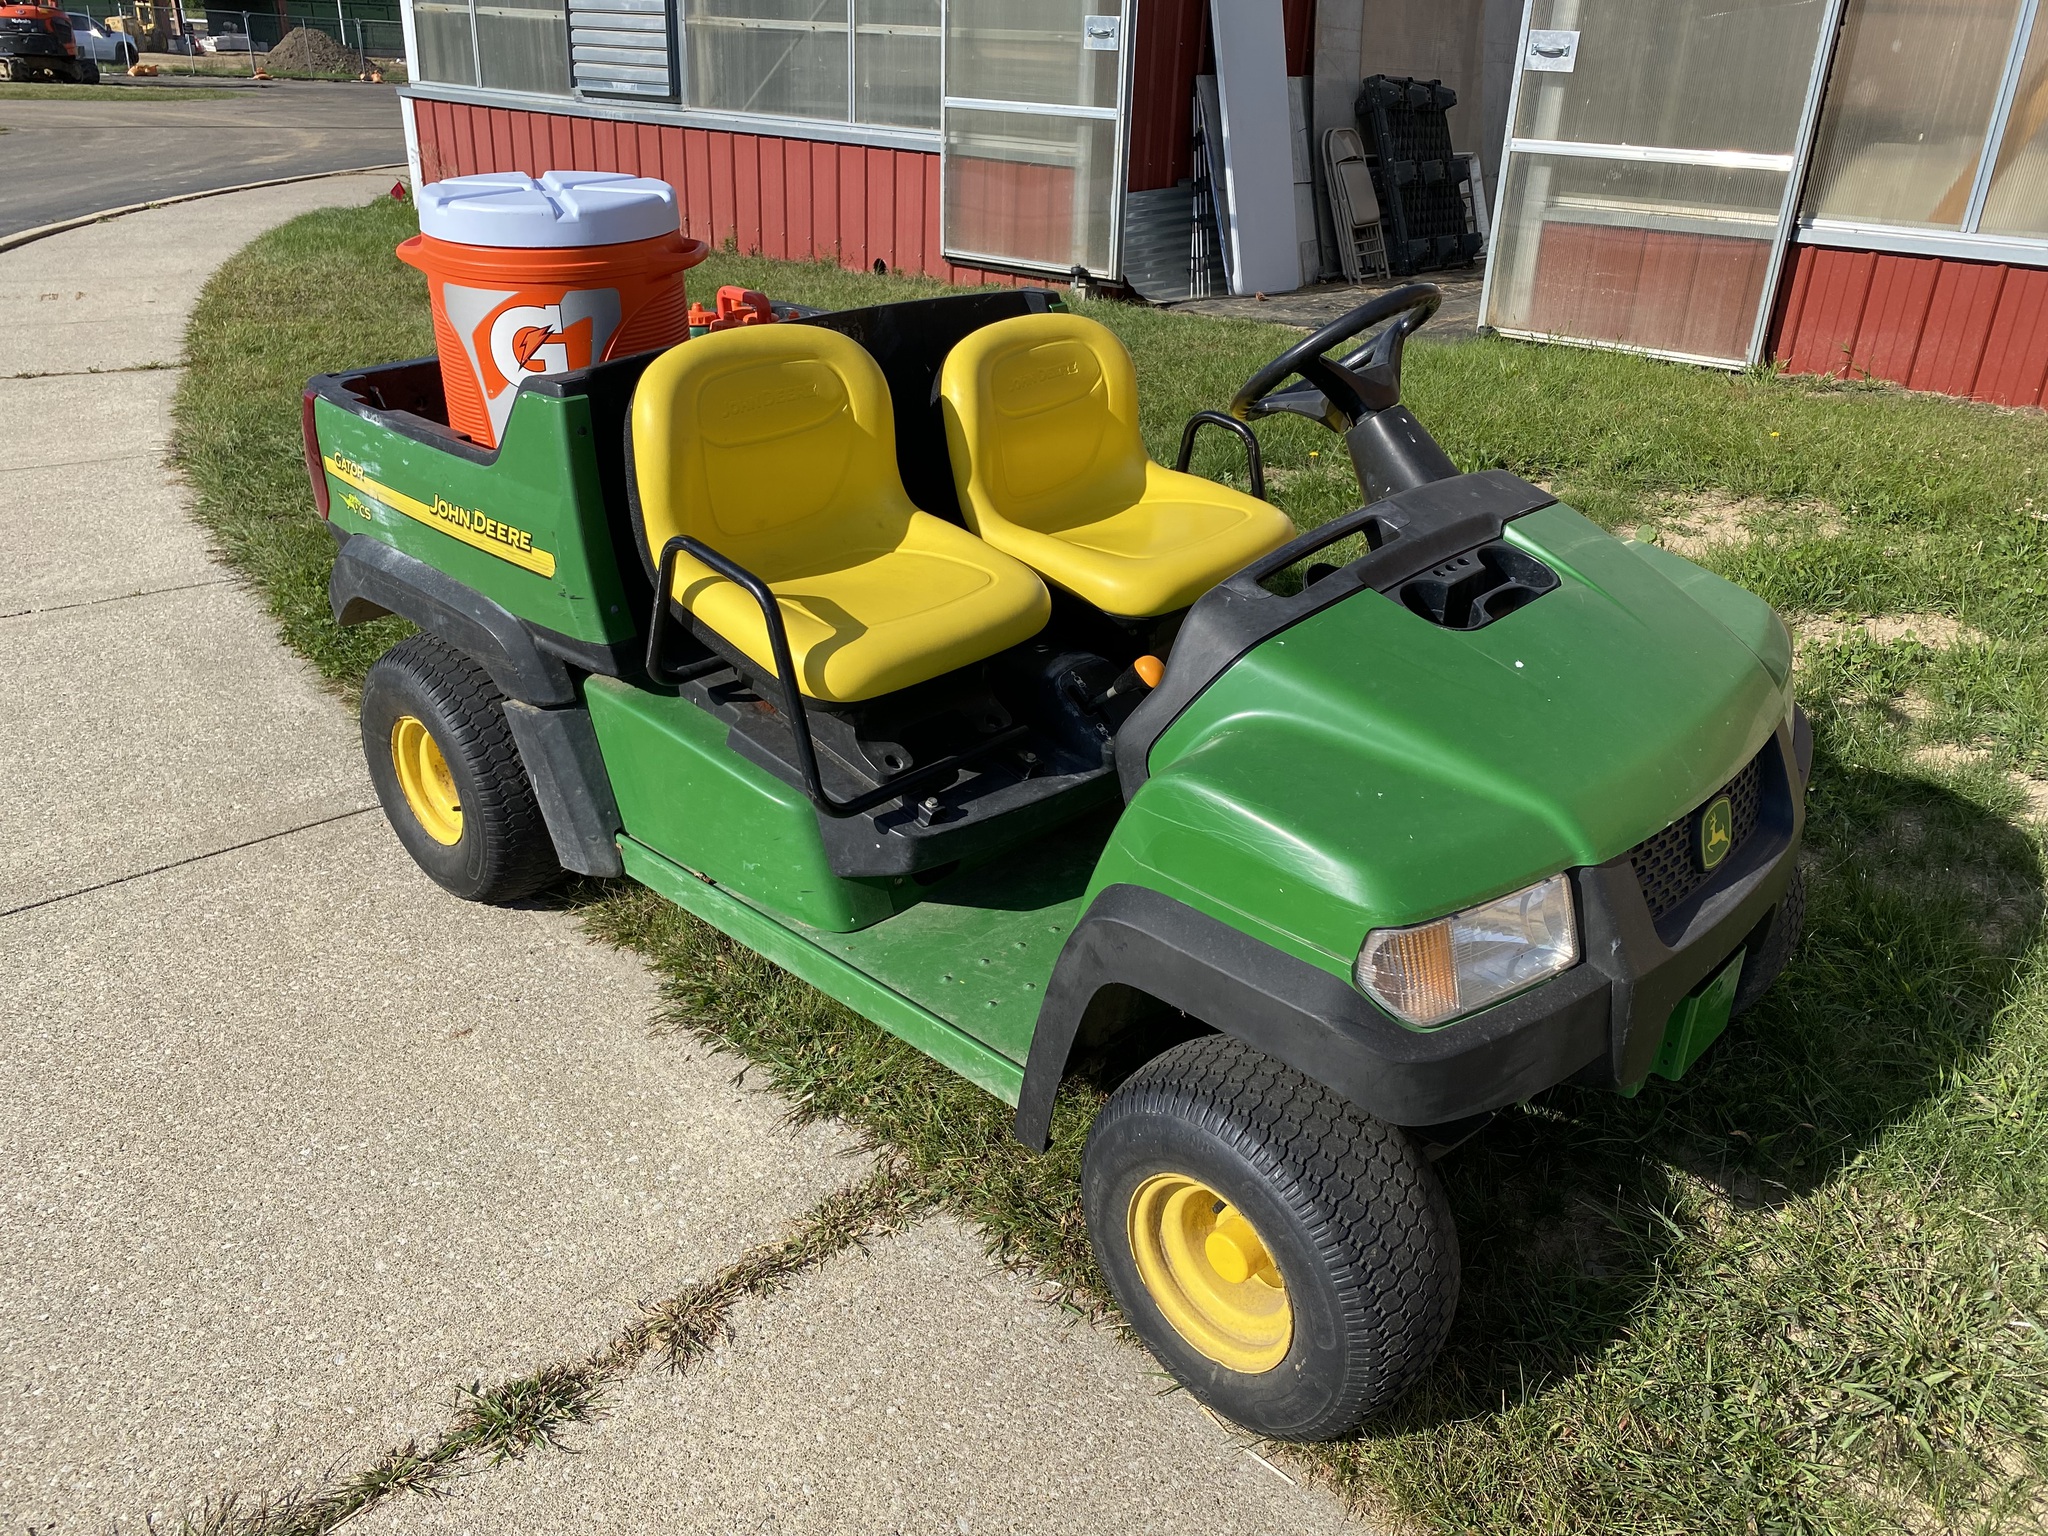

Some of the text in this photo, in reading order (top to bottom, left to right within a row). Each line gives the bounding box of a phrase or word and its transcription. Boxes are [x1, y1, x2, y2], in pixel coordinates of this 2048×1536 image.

[490, 304, 570, 388] G
[334, 451, 365, 480] GATOR
[359, 505, 372, 521] CS
[429, 493, 533, 553] JOHN DEERE
